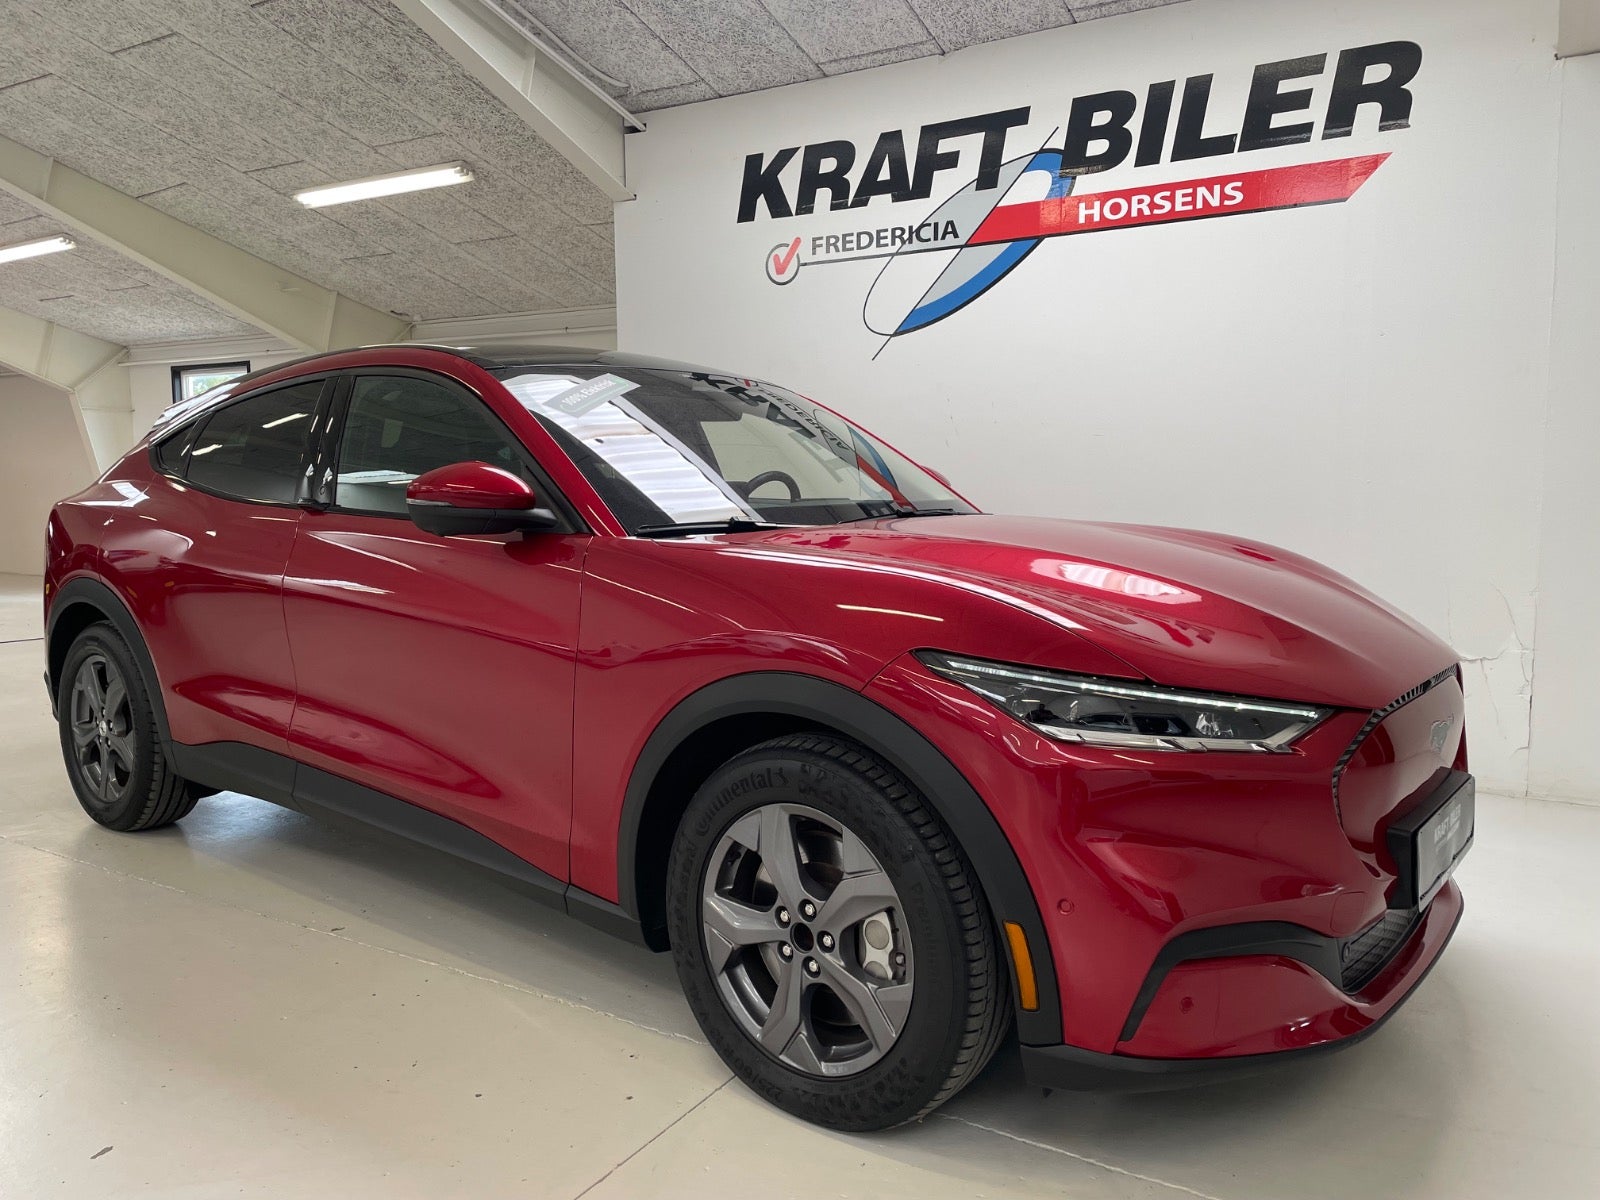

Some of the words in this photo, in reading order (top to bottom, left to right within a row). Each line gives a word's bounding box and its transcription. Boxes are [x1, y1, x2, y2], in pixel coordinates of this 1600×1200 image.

[736, 106, 1030, 224] KRAFT
[1061, 40, 1423, 178] BILER
[1077, 181, 1245, 224] HORSENS
[811, 220, 960, 256] FREDERICIA
